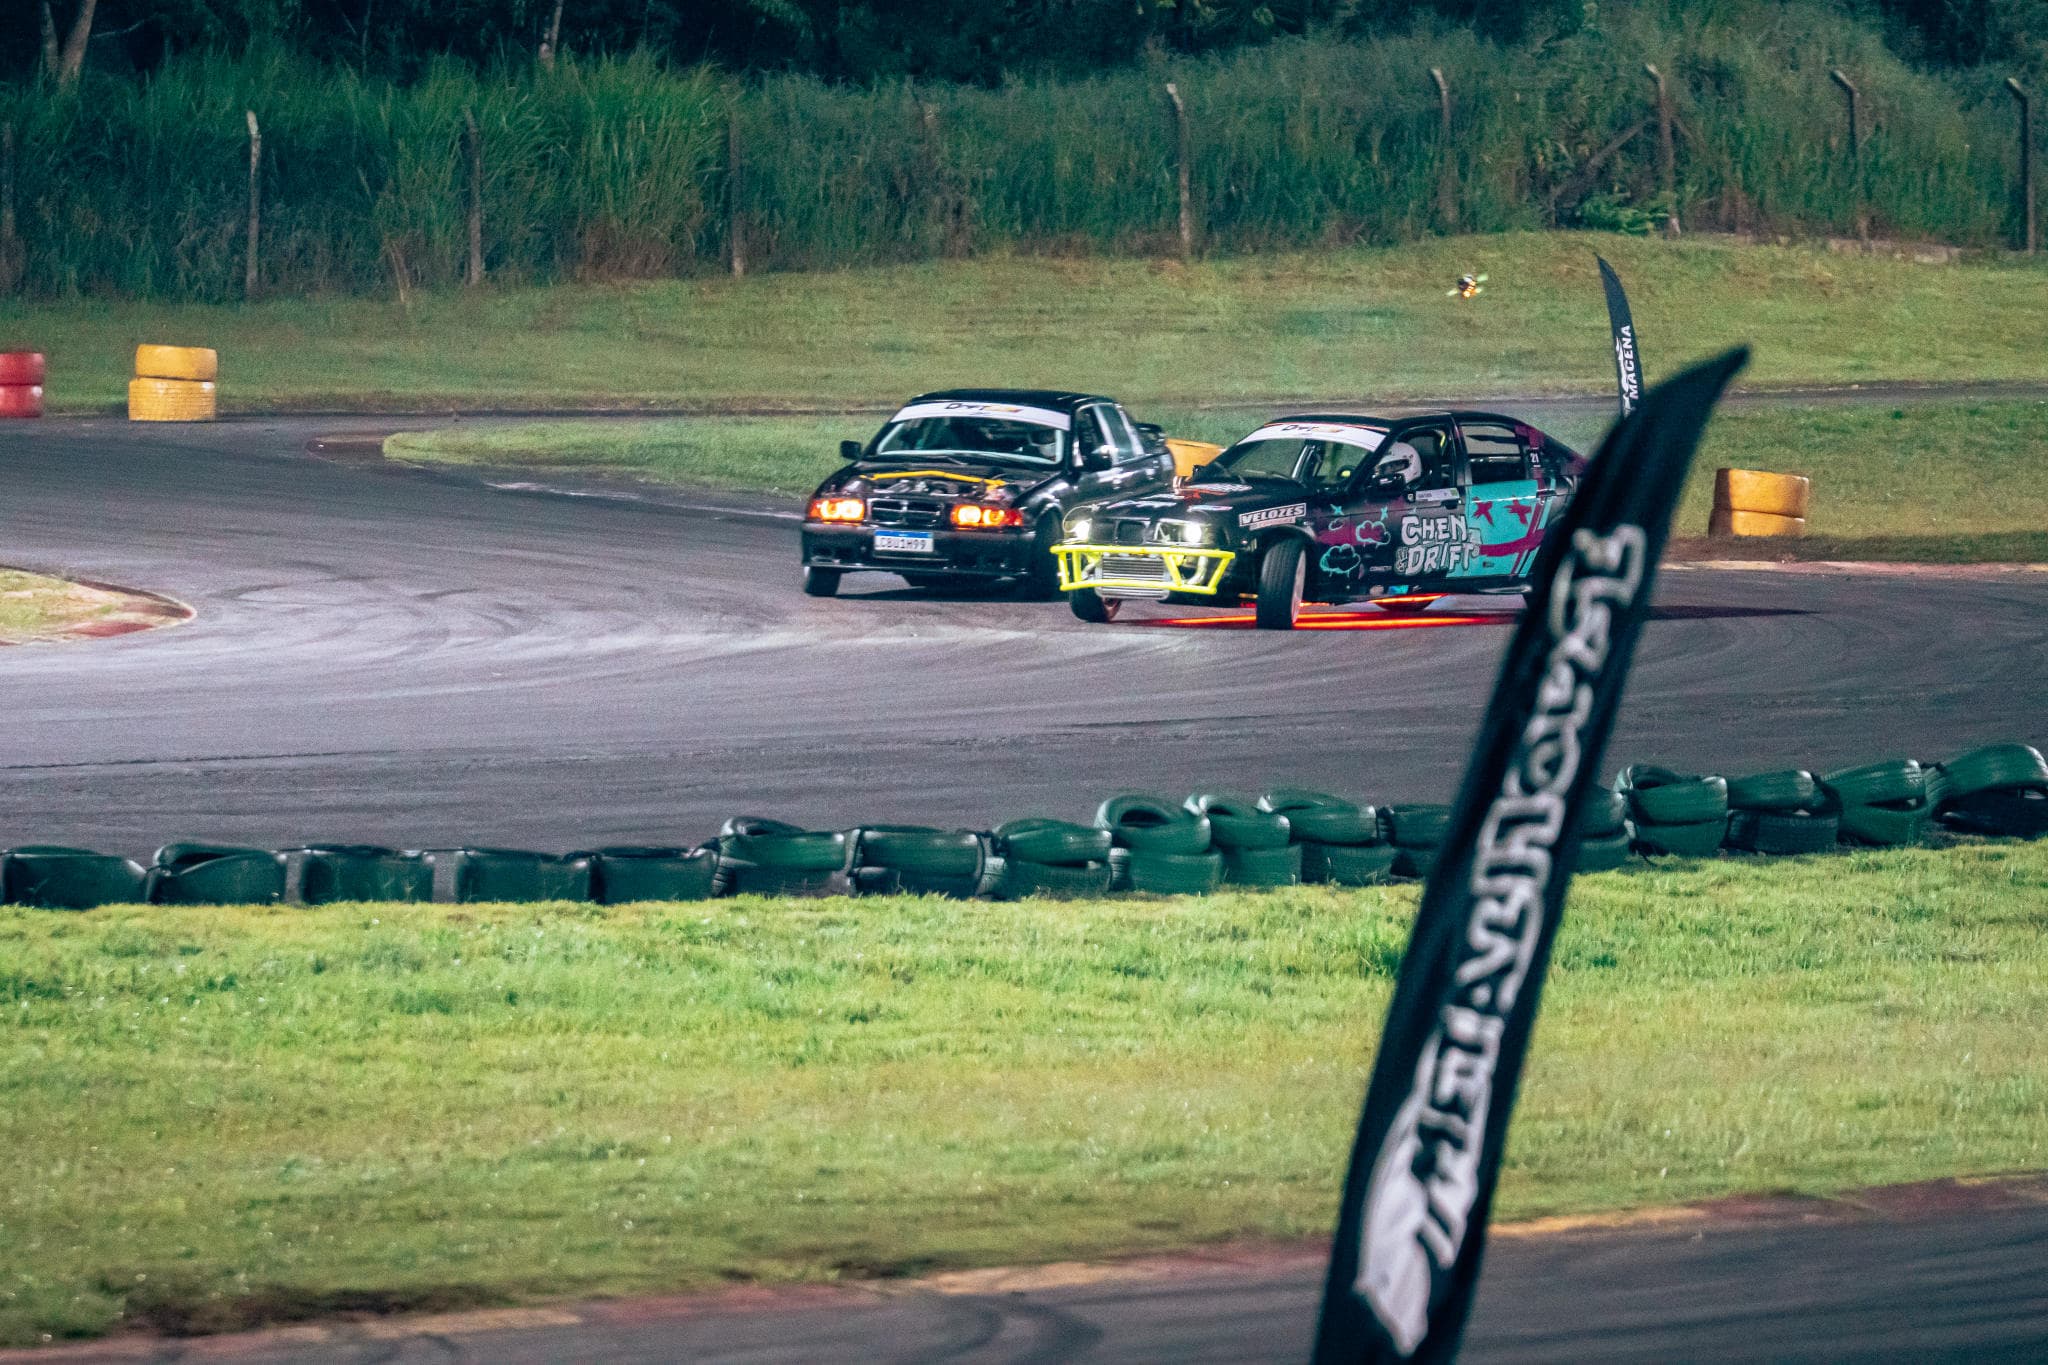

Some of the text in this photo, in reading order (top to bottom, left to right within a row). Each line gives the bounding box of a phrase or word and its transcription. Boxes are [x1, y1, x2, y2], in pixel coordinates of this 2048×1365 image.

[1621, 325, 1639, 400] MACENA
[1241, 505, 1304, 524] VELOZES
[1401, 514, 1467, 545] CHEN
[1405, 542, 1475, 575] DRIFT
